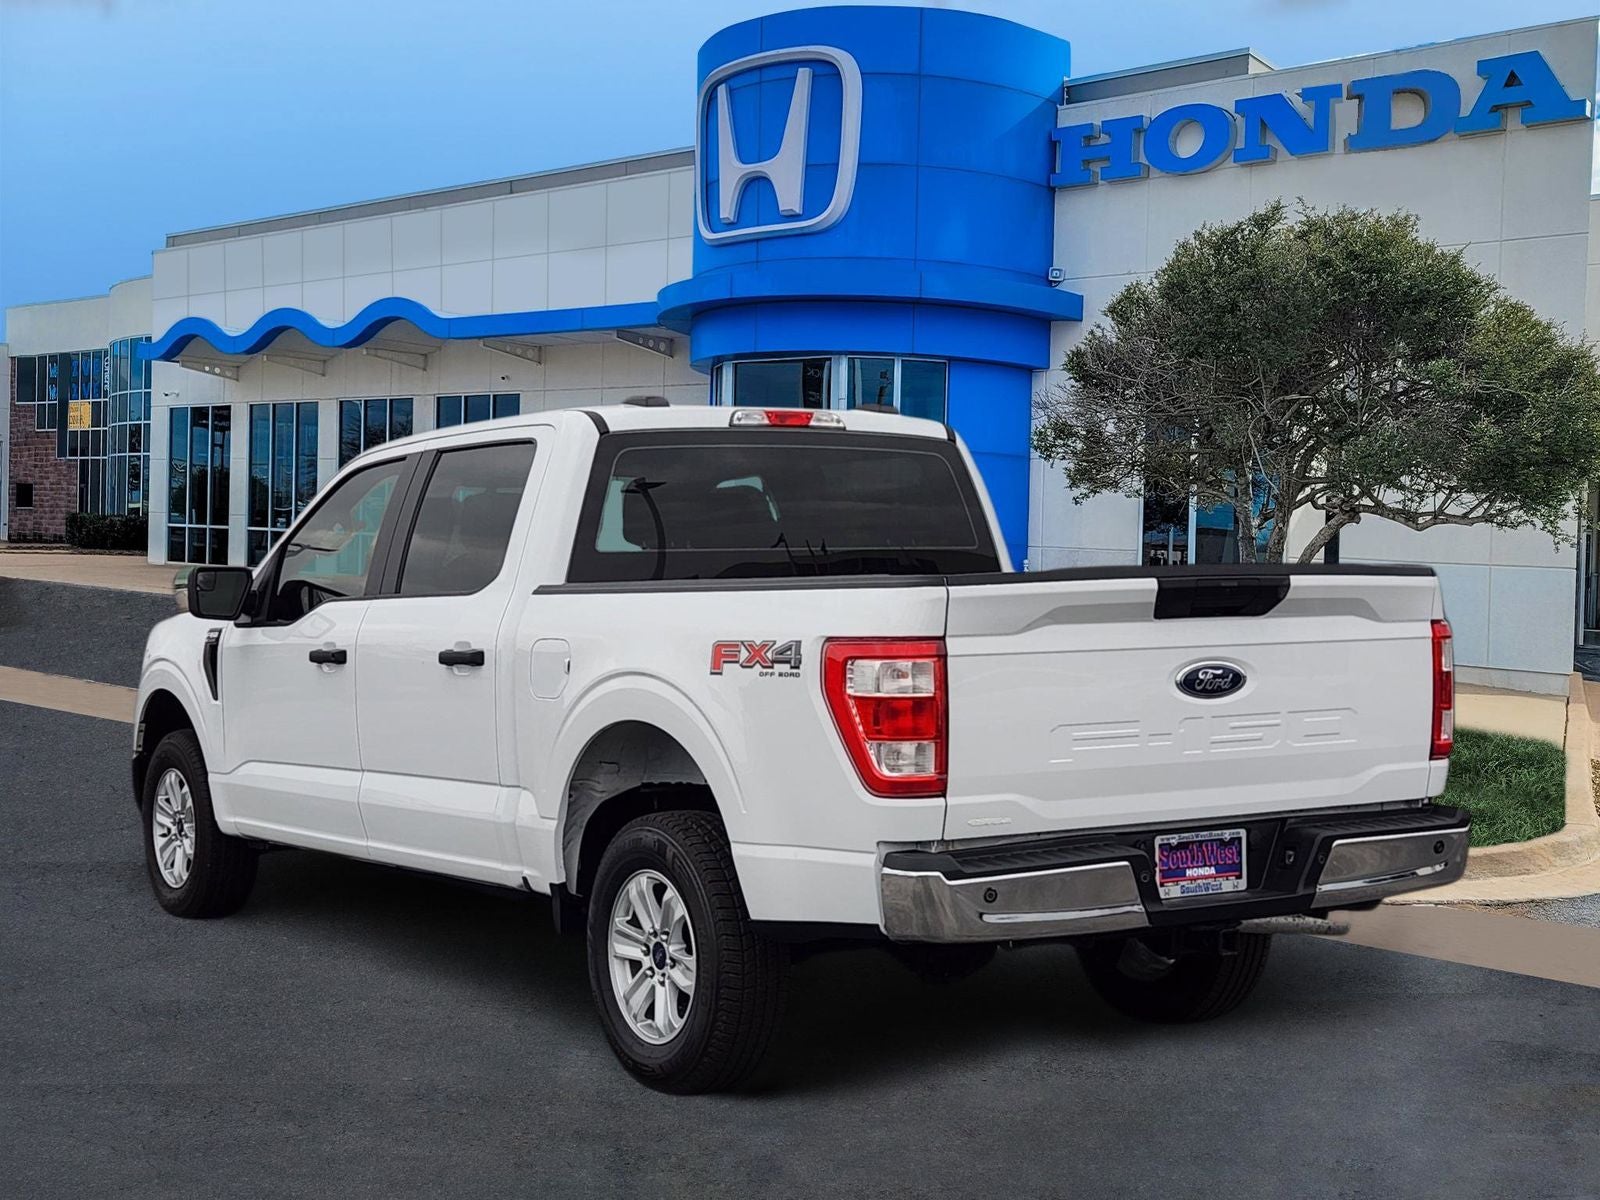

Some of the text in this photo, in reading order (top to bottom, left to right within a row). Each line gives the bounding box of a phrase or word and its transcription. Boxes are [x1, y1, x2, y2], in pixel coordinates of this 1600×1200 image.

[1050, 50, 1592, 187] HONDA
[709, 640, 802, 675] FX4
[1194, 668, 1233, 691] Ford
[1185, 866, 1216, 877] HONDA
